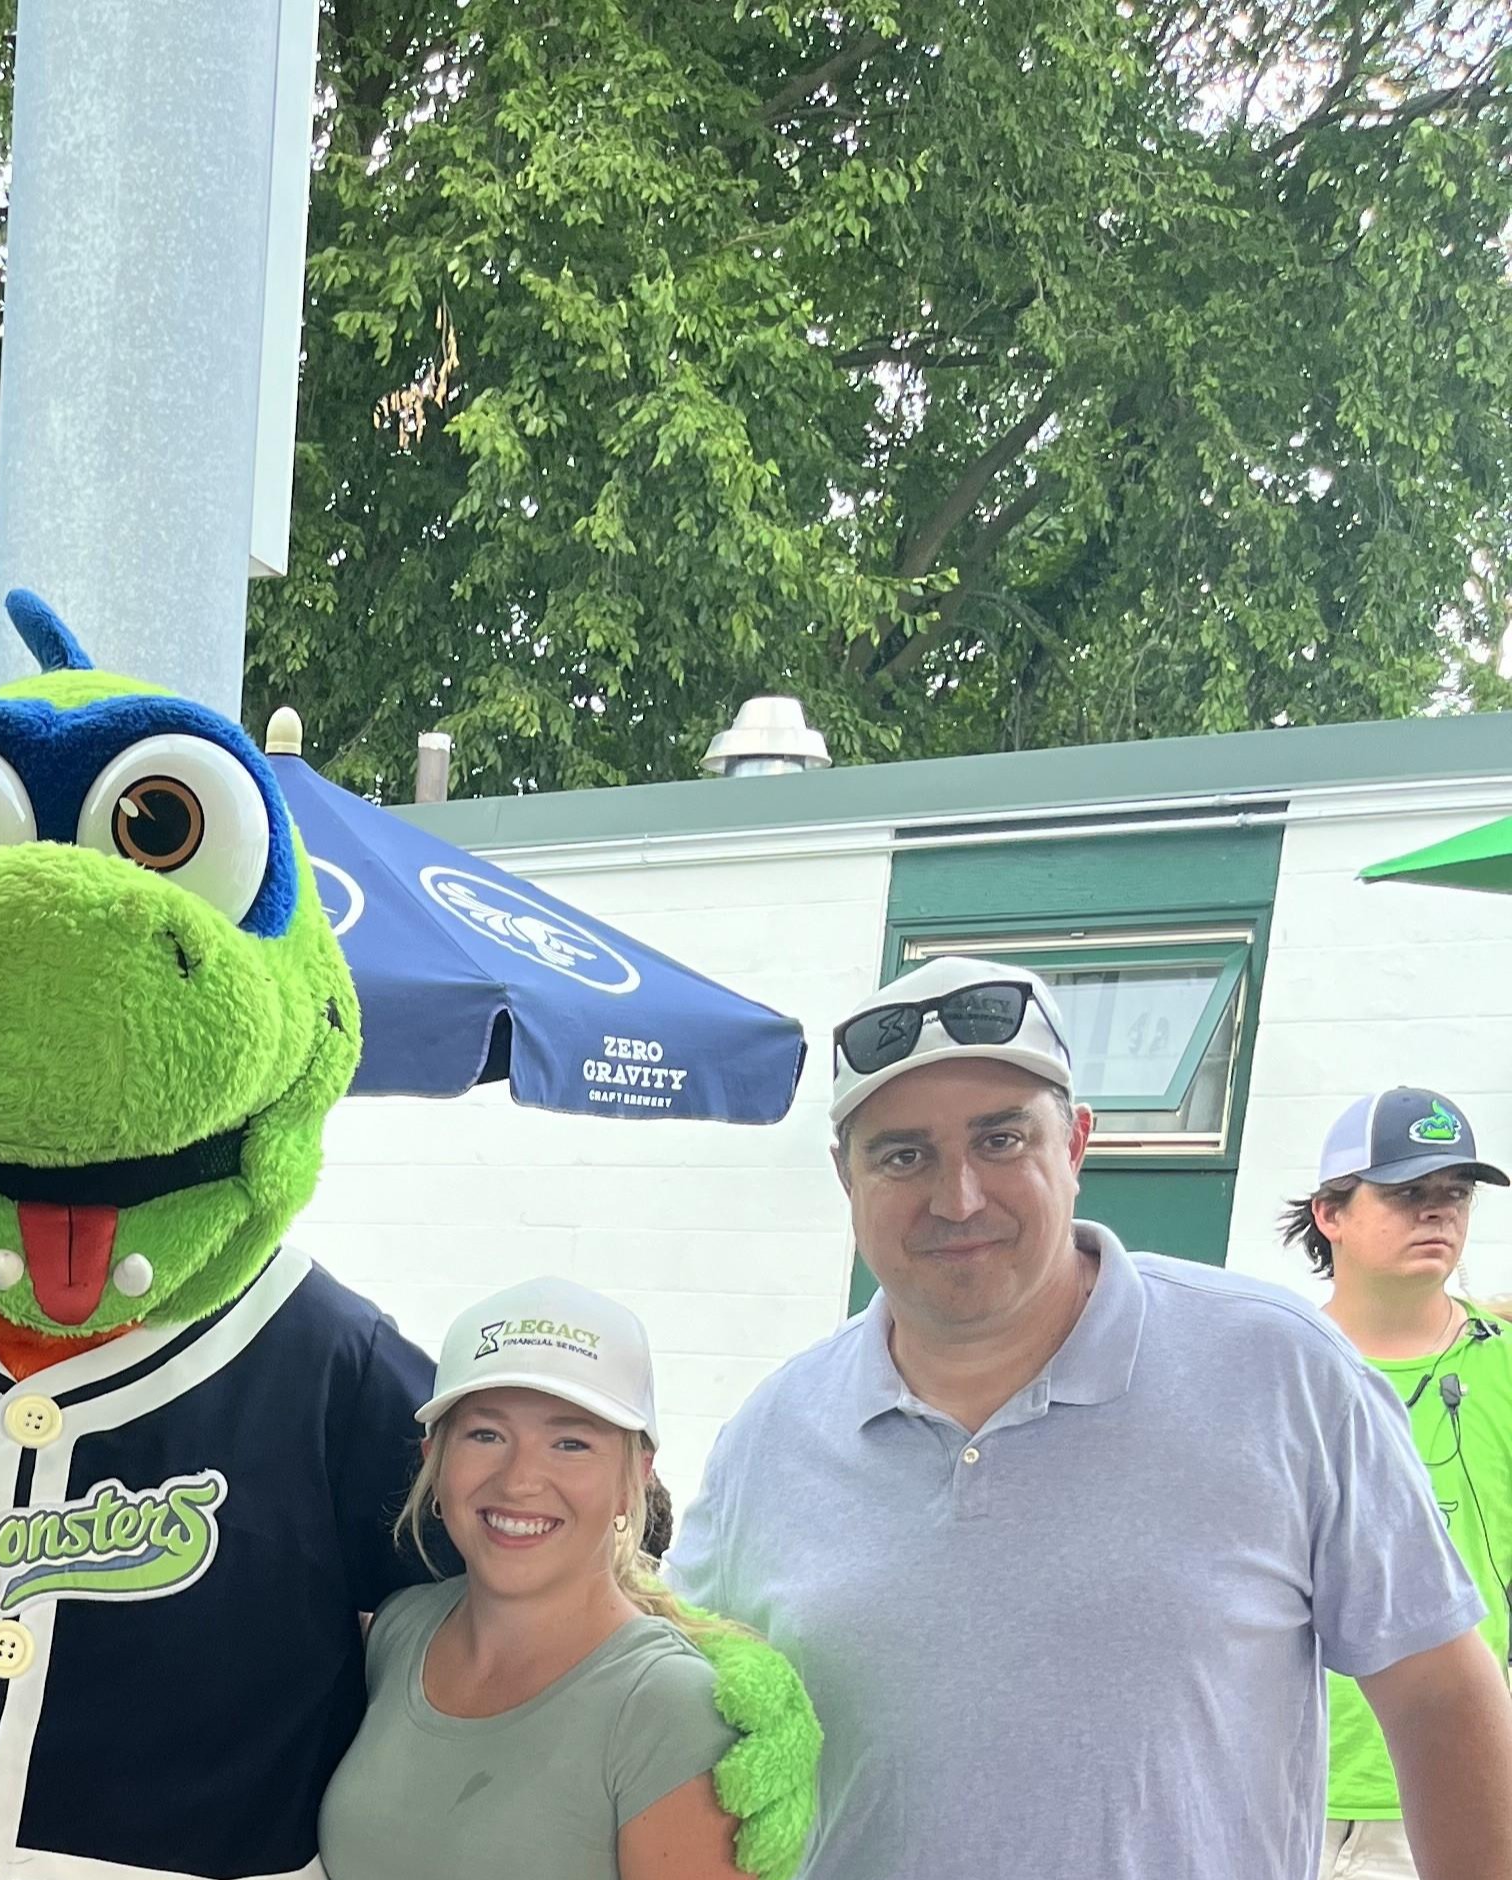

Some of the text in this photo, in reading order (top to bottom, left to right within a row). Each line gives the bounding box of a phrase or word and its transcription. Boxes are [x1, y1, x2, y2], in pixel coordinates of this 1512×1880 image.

[603, 1035, 664, 1063] ZERO
[582, 1058, 688, 1091] GRAVITY
[589, 1089, 672, 1109] CRAFT BREWERY
[503, 1319, 601, 1349] LEGACY
[502, 1337, 599, 1361] FINANCIAL SERVICES
